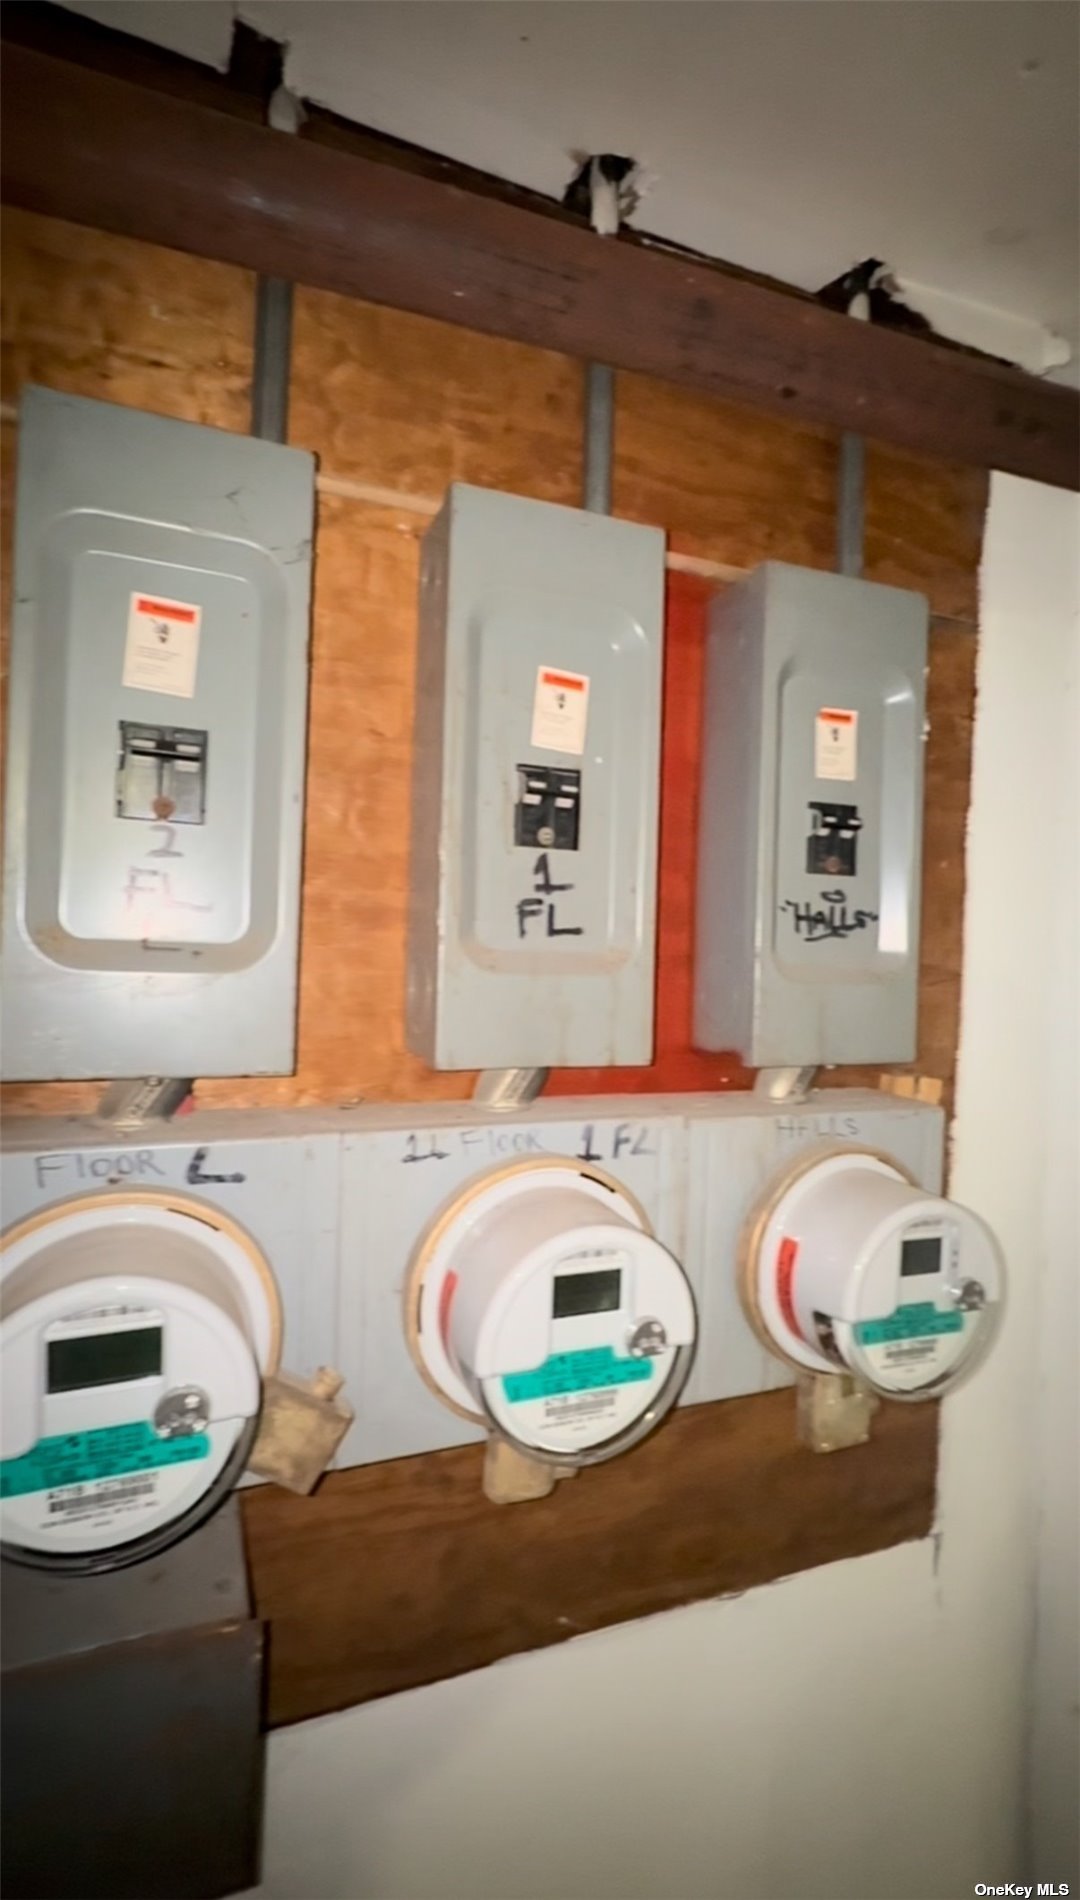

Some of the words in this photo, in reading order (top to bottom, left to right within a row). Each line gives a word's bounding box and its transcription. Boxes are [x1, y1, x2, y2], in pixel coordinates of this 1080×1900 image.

[147, 824, 184, 858] 2
[533, 852, 575, 895] 1
[516, 898, 584, 939] FL
